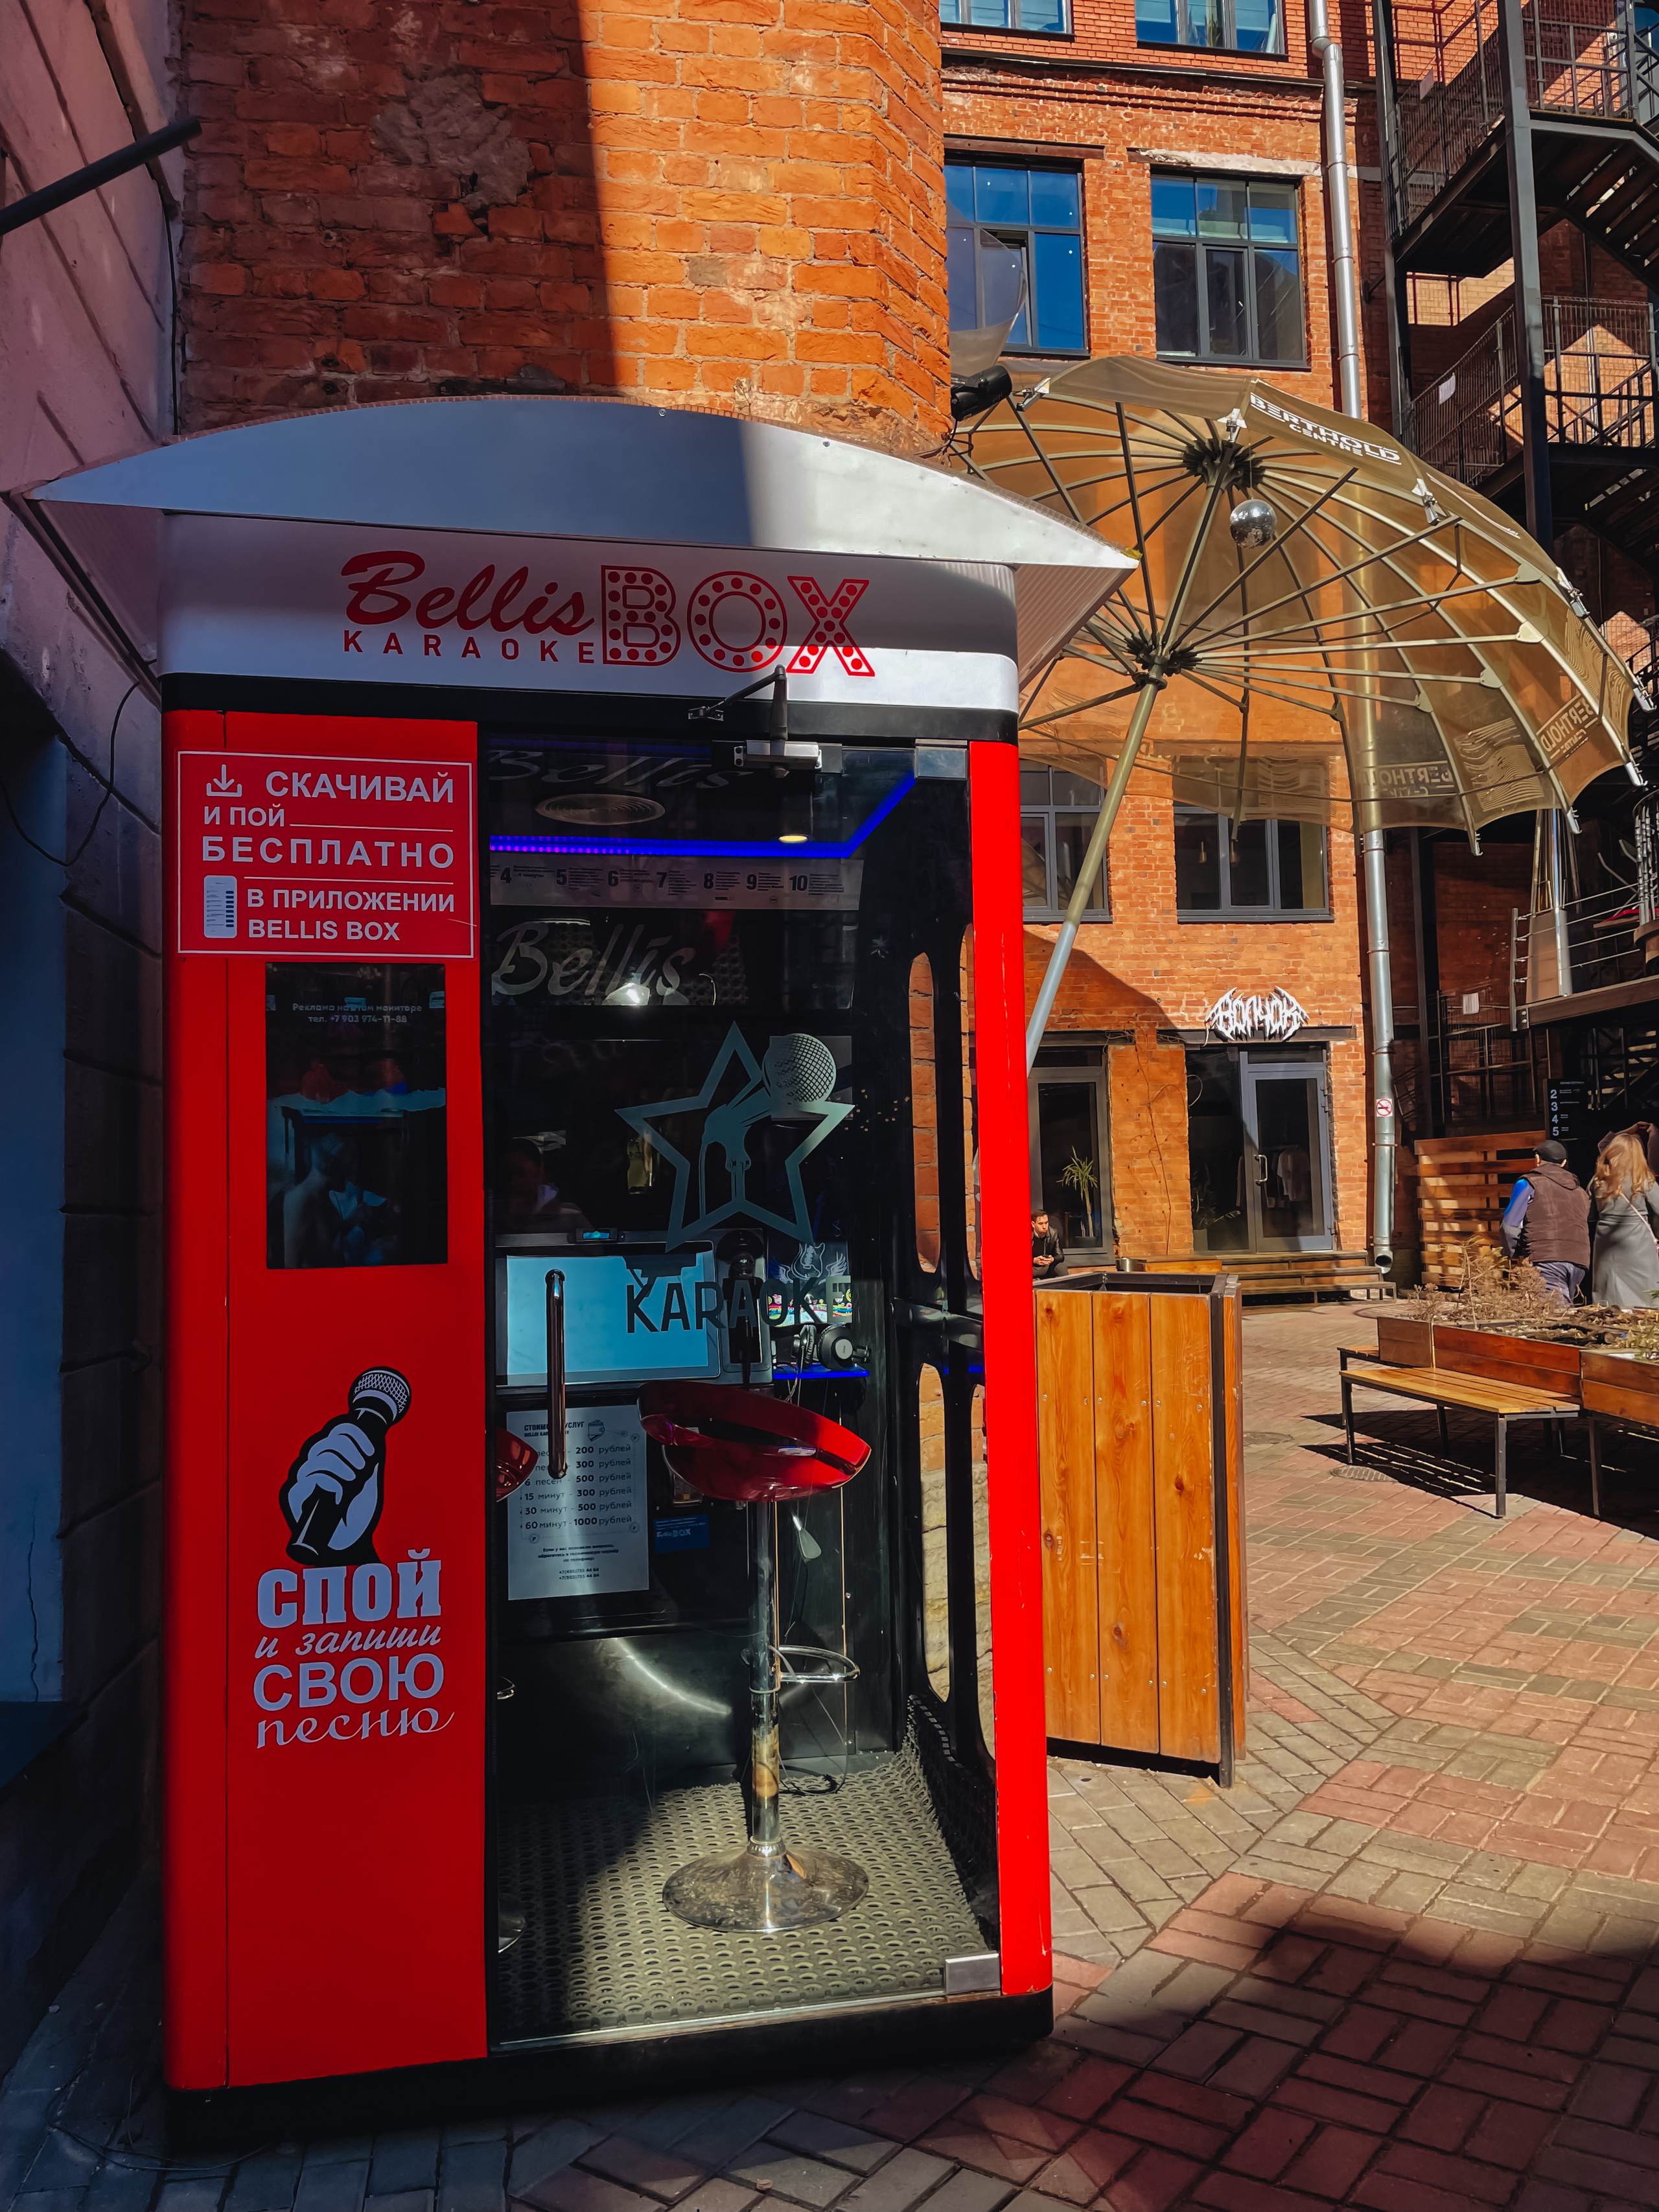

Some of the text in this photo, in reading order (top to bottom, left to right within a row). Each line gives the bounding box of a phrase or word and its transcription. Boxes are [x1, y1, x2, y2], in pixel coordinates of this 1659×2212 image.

[1250, 395, 1400, 461] BERTHOLD
[1289, 424, 1363, 456] CENTRE
[340, 550, 876, 677] Bellis BOX
[343, 629, 594, 664] KARAOKE
[266, 771, 454, 802] СКАЧИВАЙ
[204, 803, 284, 827] И ПОЙ
[202, 836, 454, 868] БЕСПЛАТНО
[500, 867, 512, 883] 4
[556, 869, 567, 885] 5
[608, 870, 620, 887] 6
[656, 872, 667, 888] 7
[703, 873, 713, 889] 8
[747, 874, 757, 890] 9
[789, 875, 808, 891] 10
[248, 889, 264, 907] В
[273, 890, 454, 913] ПРИЛОЖЕНИИ
[249, 919, 400, 941] BELLIS BOX
[496, 921, 696, 996] Bellis
[292, 1003, 335, 1011] Реклама
[1550, 1089, 1557, 1099] 2
[1551, 1102, 1558, 1112] 3
[1552, 1114, 1559, 1123] 4
[1553, 1126, 1559, 1136] 5
[626, 1275, 852, 1334] KARAOKE
[575, 1446, 594, 1454] 200
[599, 1444, 631, 1454] рублей
[576, 1458, 631, 1469] 300 рублей
[576, 1474, 594, 1483] 500
[599, 1473, 631, 1482] рублей
[577, 1489, 596, 1497] 300
[599, 1487, 632, 1497] рублей
[577, 1503, 596, 1511] 500
[599, 1500, 632, 1511] рублей
[525, 1515, 632, 1530] 60 минут 1000 рублей
[257, 1548, 441, 1628] СПОЙ
[255, 1625, 441, 1659] и запиши
[253, 1653, 444, 1711] СВОЮ
[257, 1708, 455, 1749] песню
